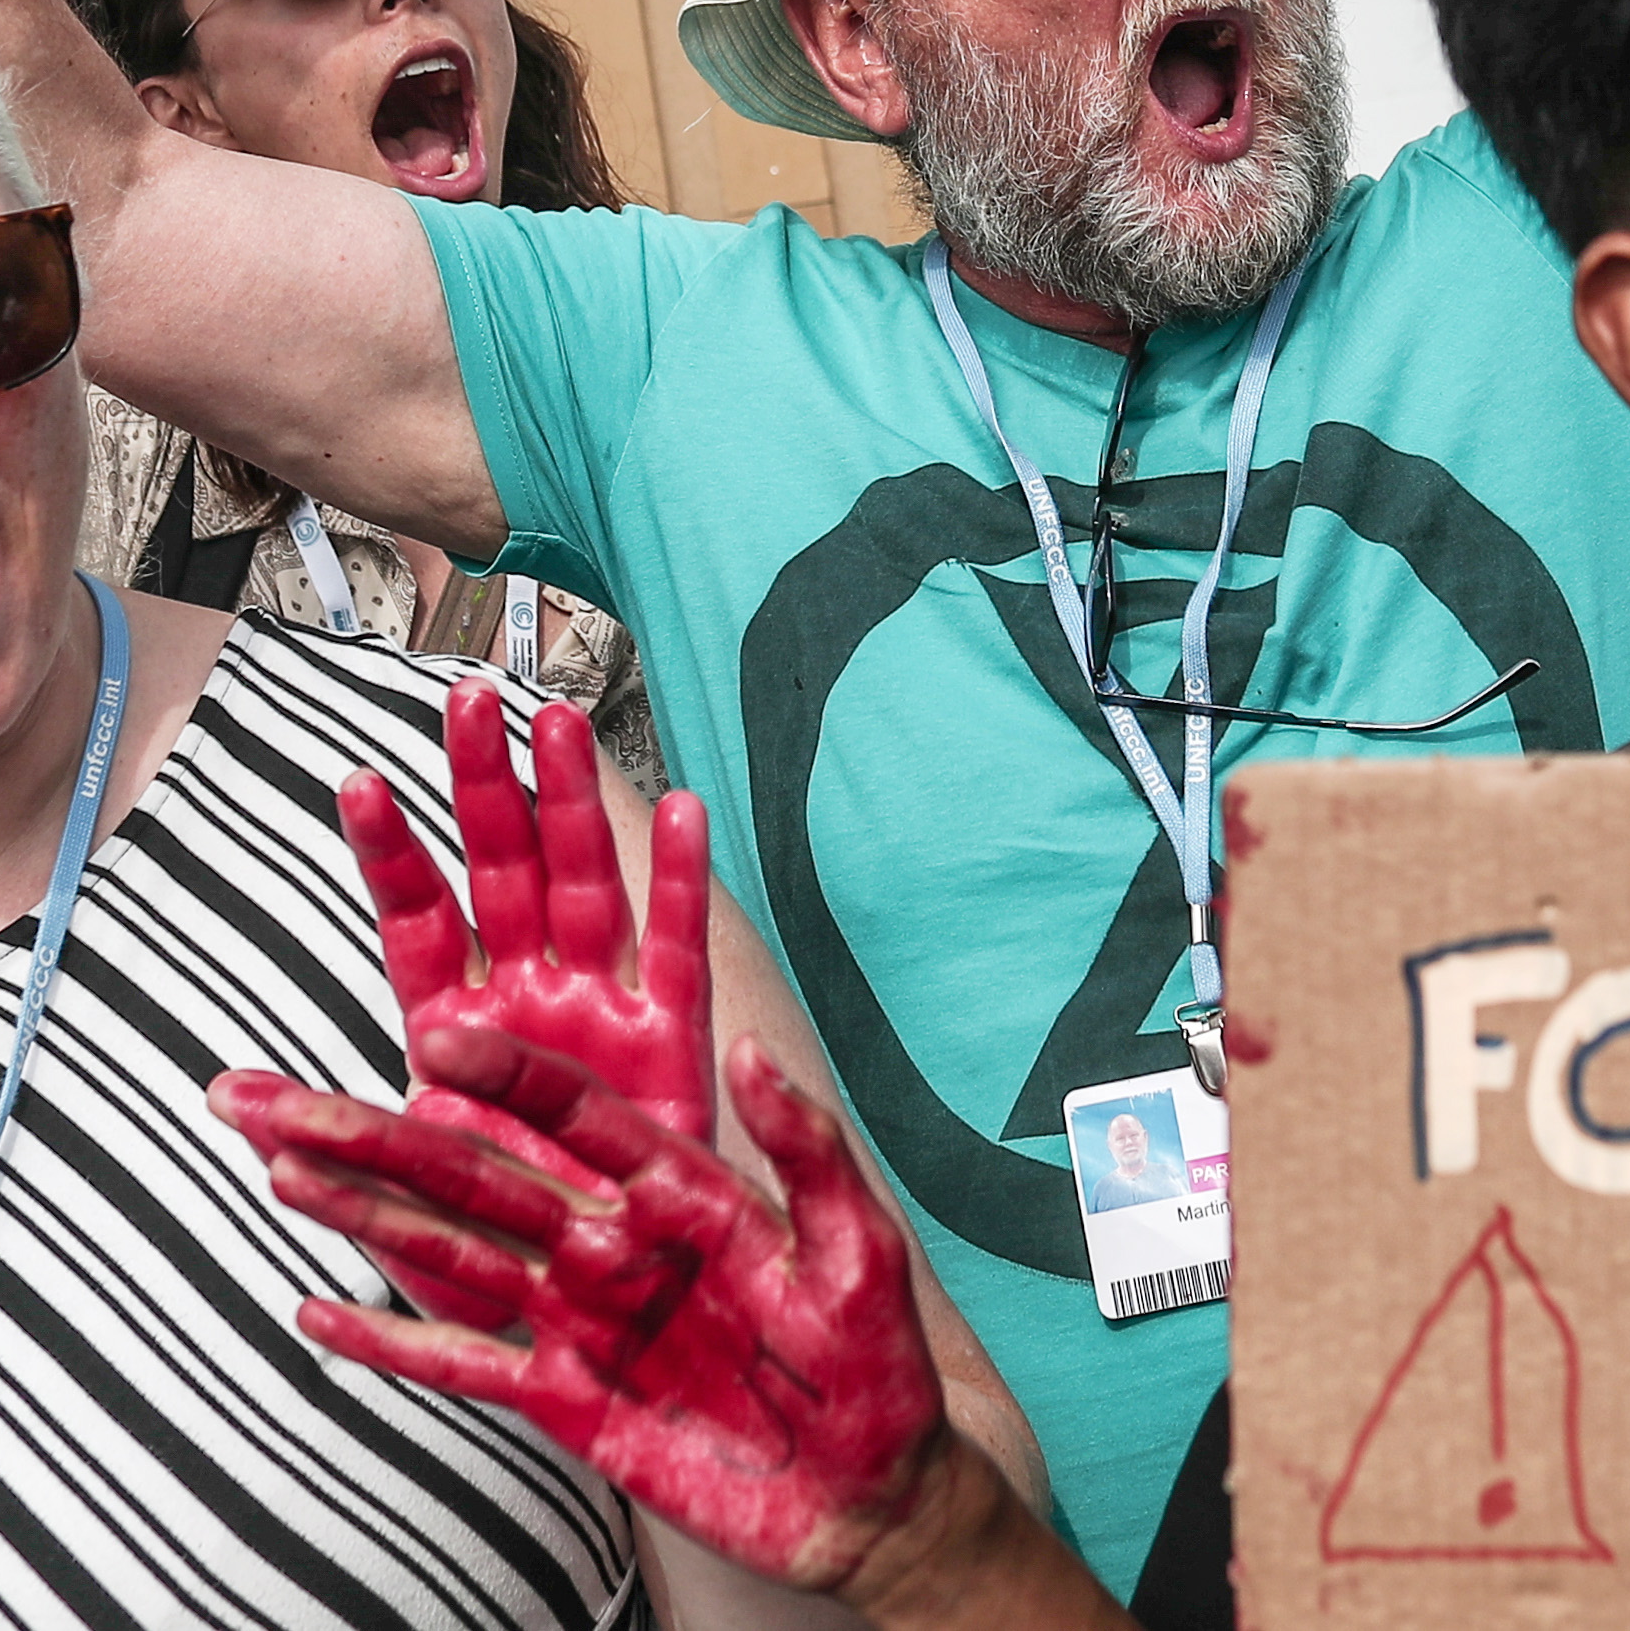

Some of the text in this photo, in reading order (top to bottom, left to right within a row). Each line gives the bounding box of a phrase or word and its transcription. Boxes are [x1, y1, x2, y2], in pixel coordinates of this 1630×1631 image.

[1028, 477, 1068, 583] UNFCCC
[81, 676, 121, 800] unfccc.int
[1109, 690, 1167, 797] nfccc.int
[1191, 1162, 1230, 1185] PAR
